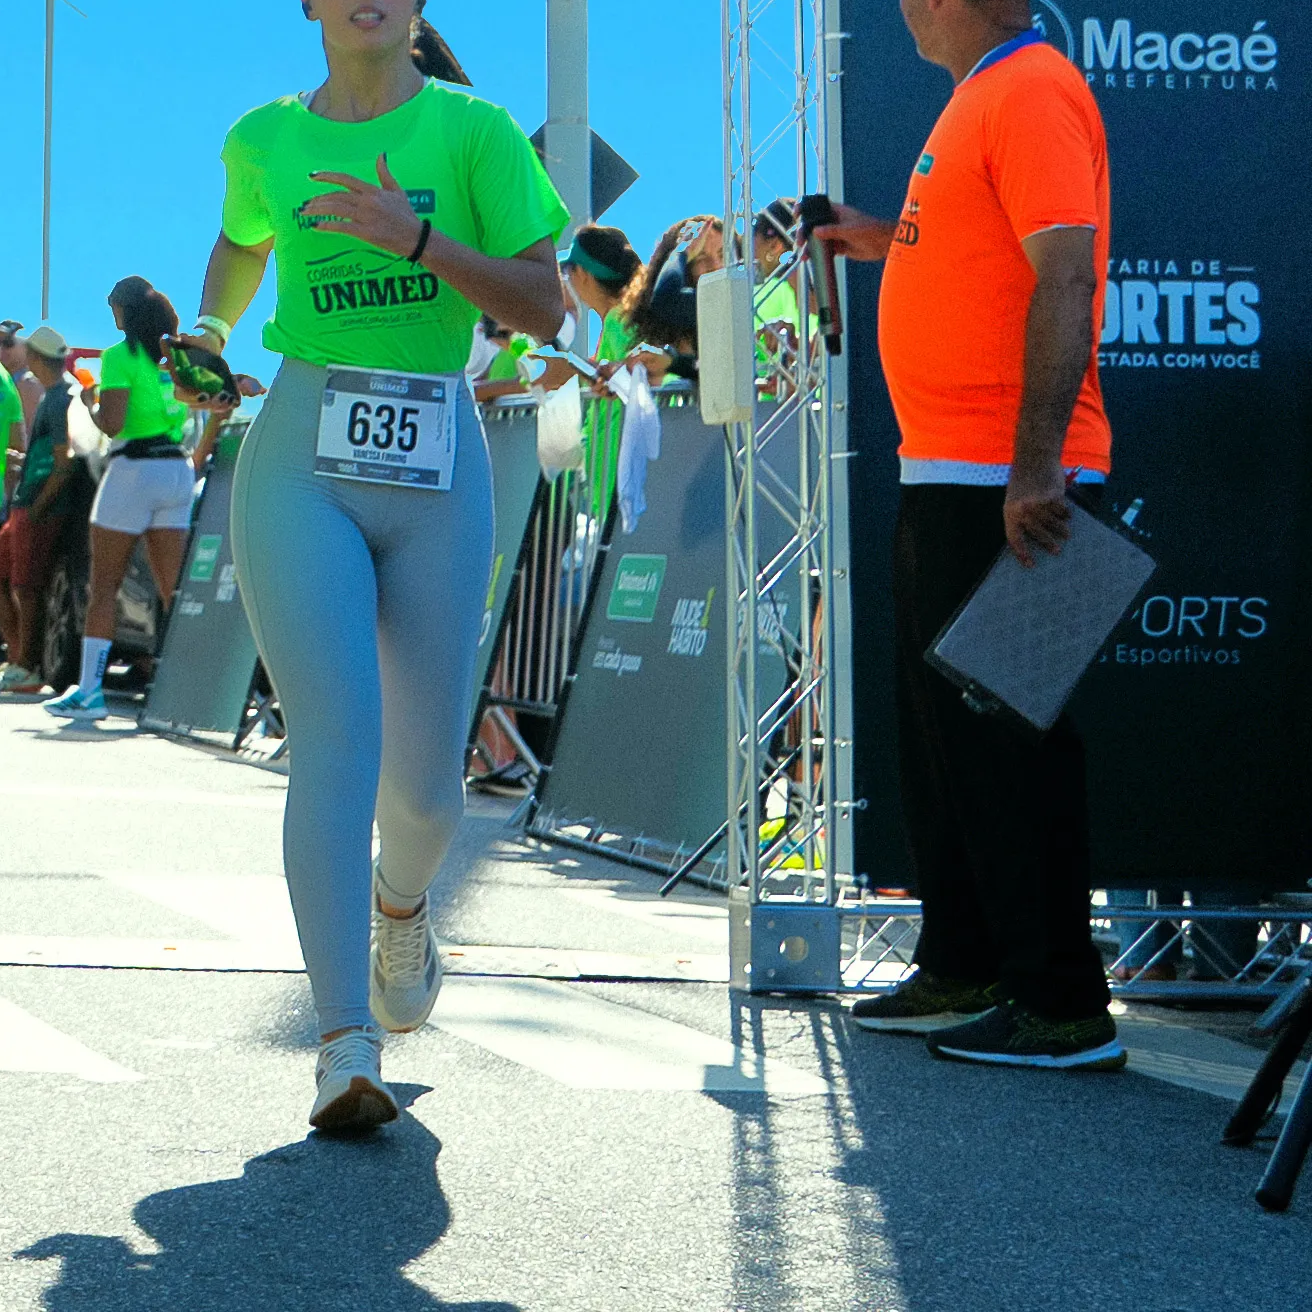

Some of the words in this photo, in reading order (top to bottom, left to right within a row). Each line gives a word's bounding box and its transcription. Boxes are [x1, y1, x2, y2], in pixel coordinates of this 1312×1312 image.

[1082, 17, 1277, 72] Macaé
[1084, 73, 1278, 90] PREFEITURA
[1191, 260, 1220, 275] DE
[310, 272, 440, 314] UNIMED
[1163, 353, 1206, 368] COM
[1211, 350, 1261, 369] VOCÊ
[347, 401, 420, 452] 635
[1116, 644, 1241, 668] Esportivos
